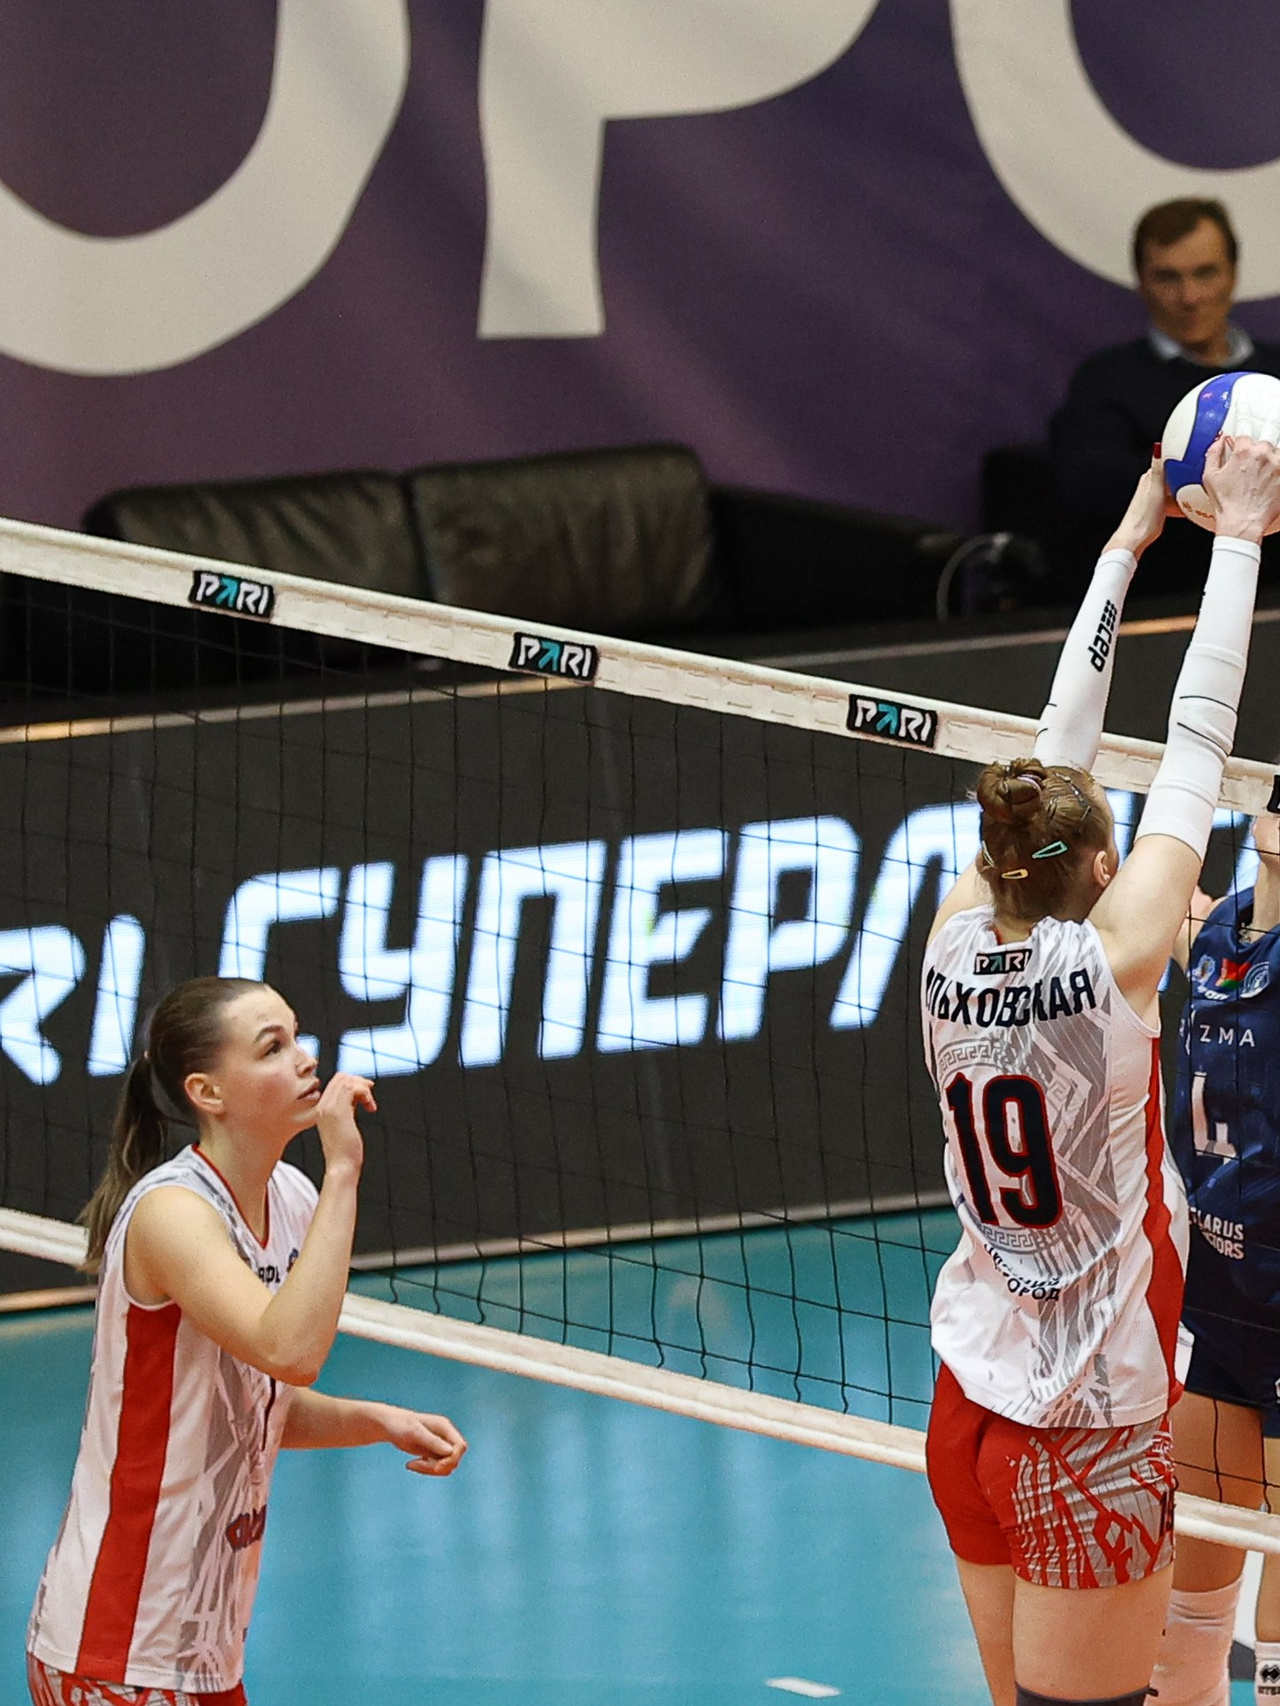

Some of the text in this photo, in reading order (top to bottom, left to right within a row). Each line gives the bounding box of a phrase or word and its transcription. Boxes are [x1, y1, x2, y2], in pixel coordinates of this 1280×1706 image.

[195, 572, 270, 615] PARI
[517, 636, 592, 677] PARI
[854, 698, 932, 742] PARI
[945, 1072, 1064, 1229] 19
